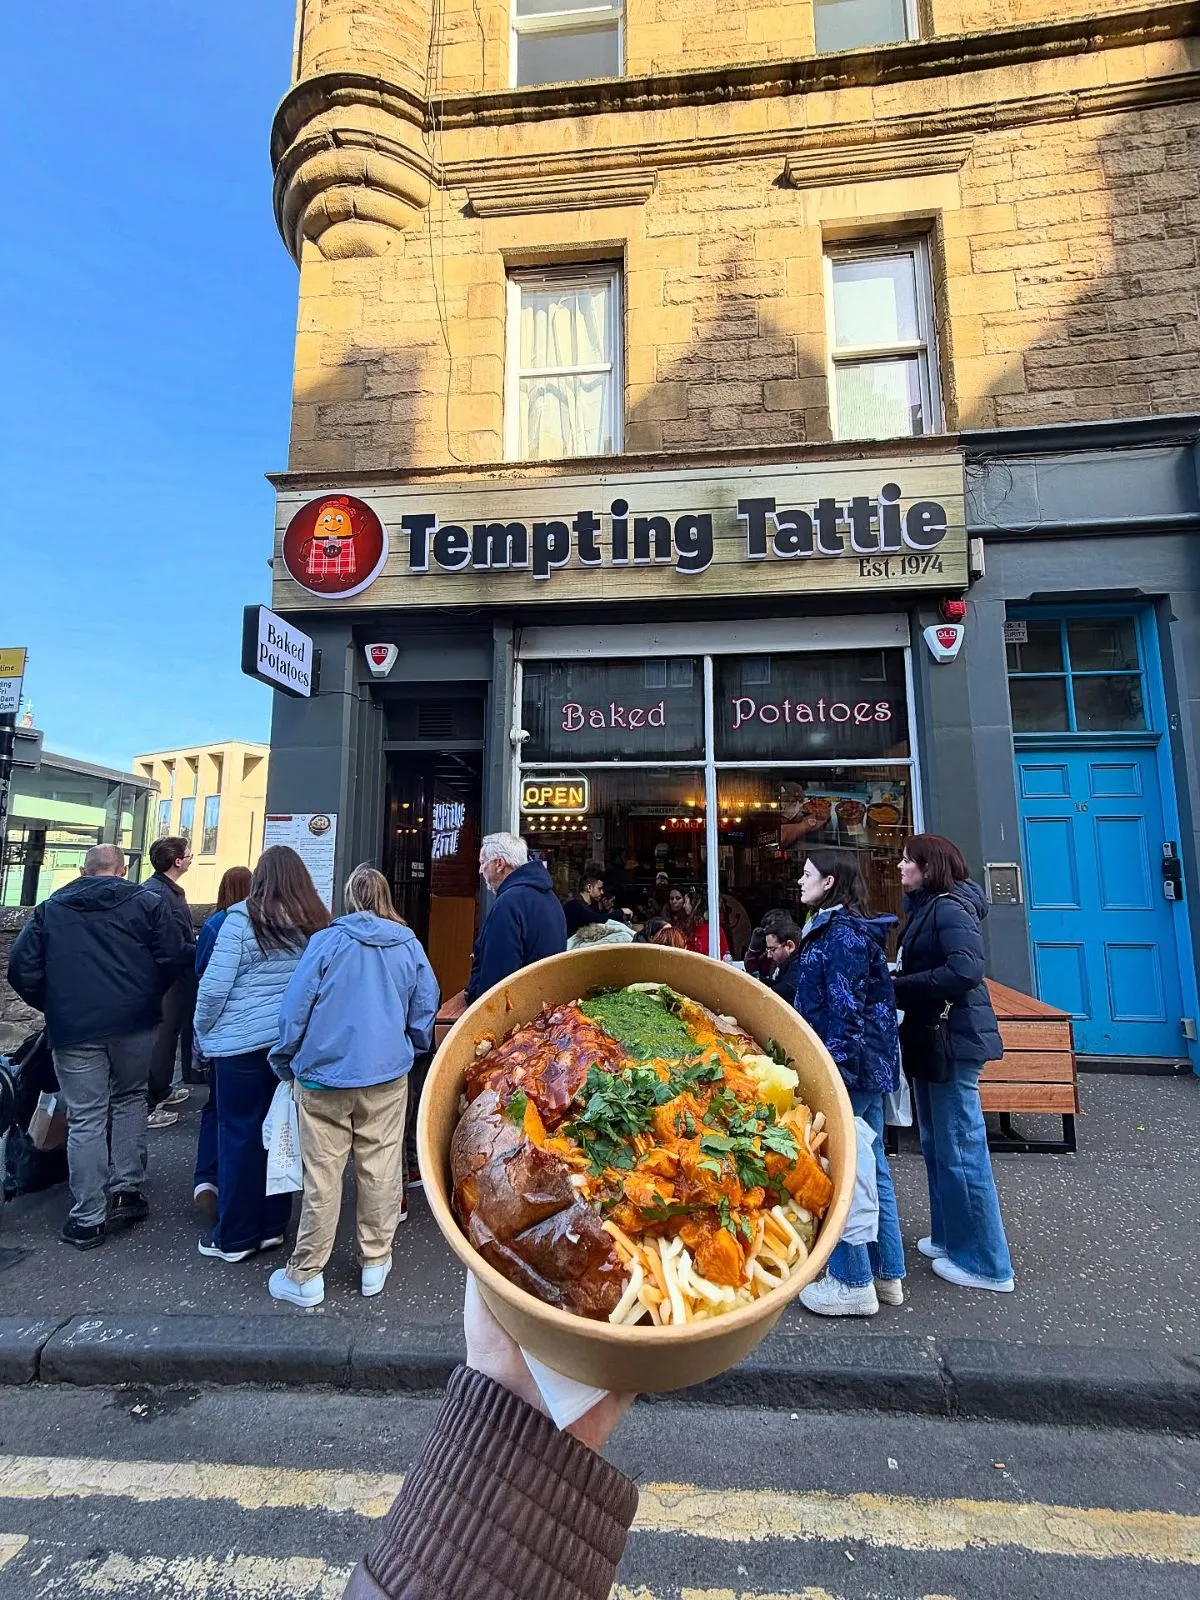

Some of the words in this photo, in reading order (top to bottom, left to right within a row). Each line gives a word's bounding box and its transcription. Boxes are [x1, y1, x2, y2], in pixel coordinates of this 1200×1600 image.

[401, 498, 714, 580] Tempting
[737, 483, 947, 558] Tattie
[859, 557, 896, 579] Est.
[900, 554, 944, 575] 1974
[267, 622, 305, 662] Baked
[260, 641, 309, 687] Potatoes
[561, 700, 667, 733] Baked
[731, 696, 893, 731] Potatoes
[525, 787, 584, 804] OPEN
